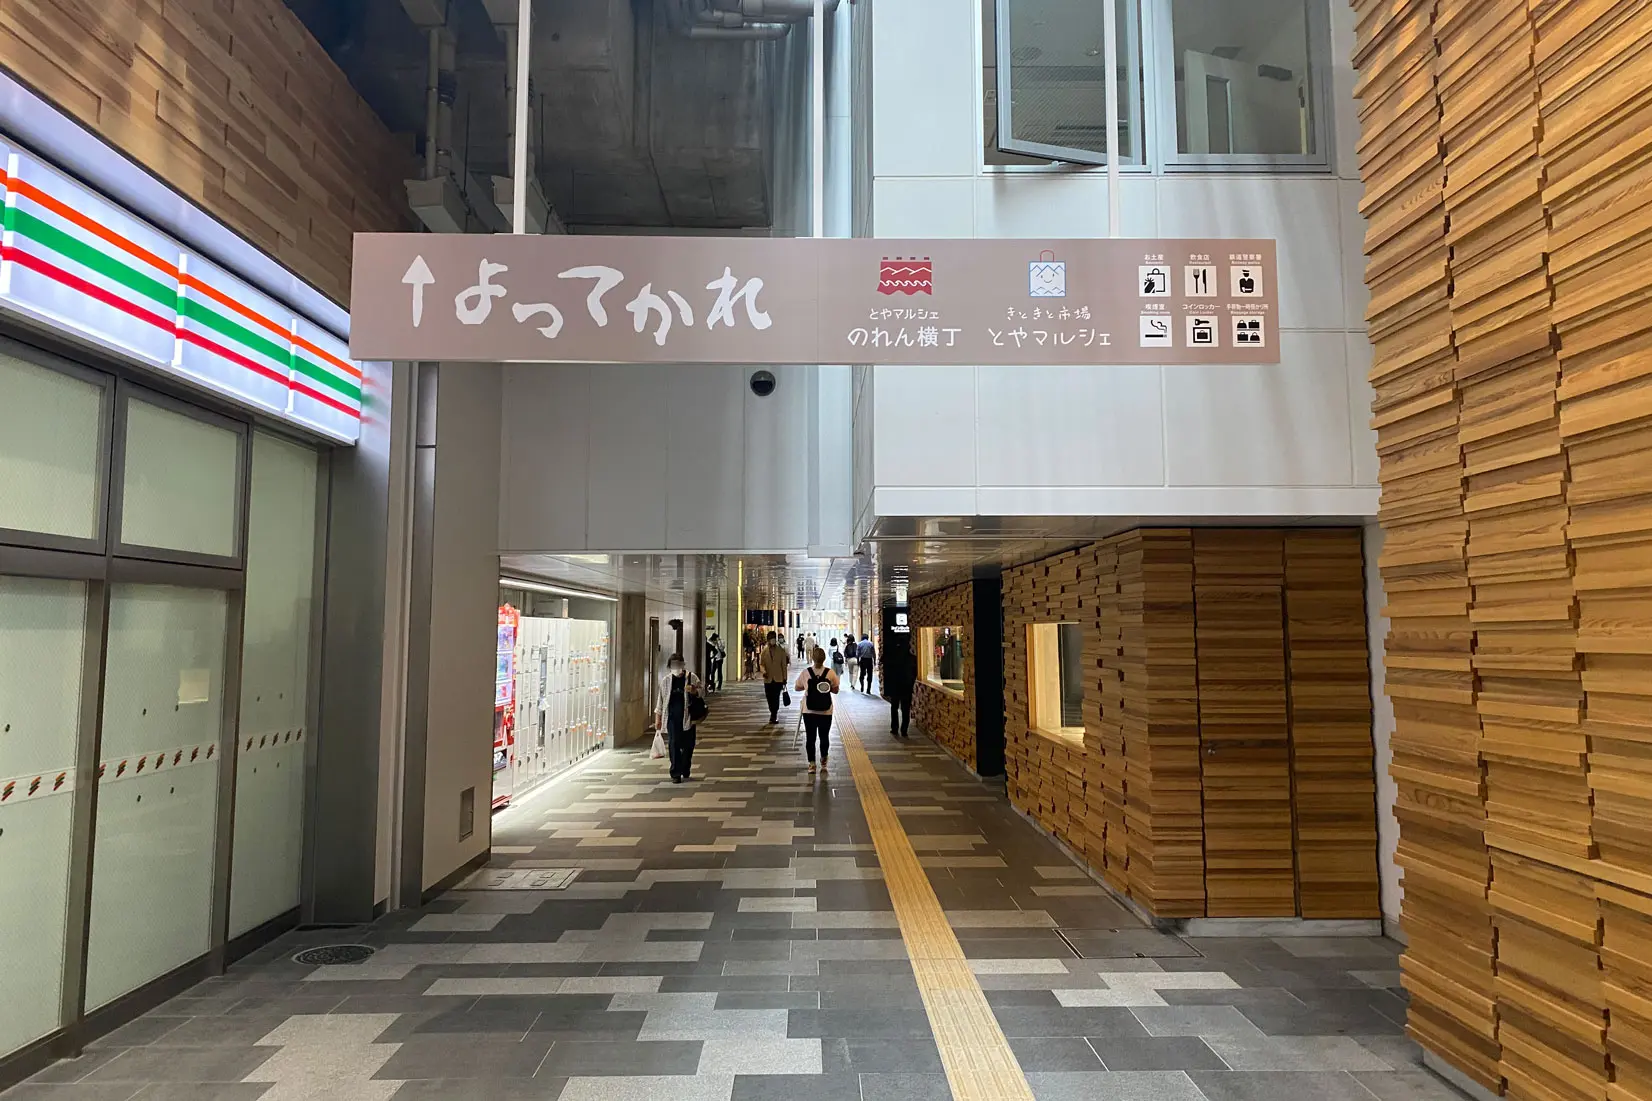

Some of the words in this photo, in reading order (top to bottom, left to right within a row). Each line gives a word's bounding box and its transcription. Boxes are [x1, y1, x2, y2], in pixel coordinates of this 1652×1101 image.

[454, 257, 773, 346] よってかれ
[869, 308, 940, 320] とやマルシェ
[1007, 306, 1091, 320] きときと市場
[847, 326, 962, 348] のれん横丁
[987, 327, 1112, 348] とやマルシェ
